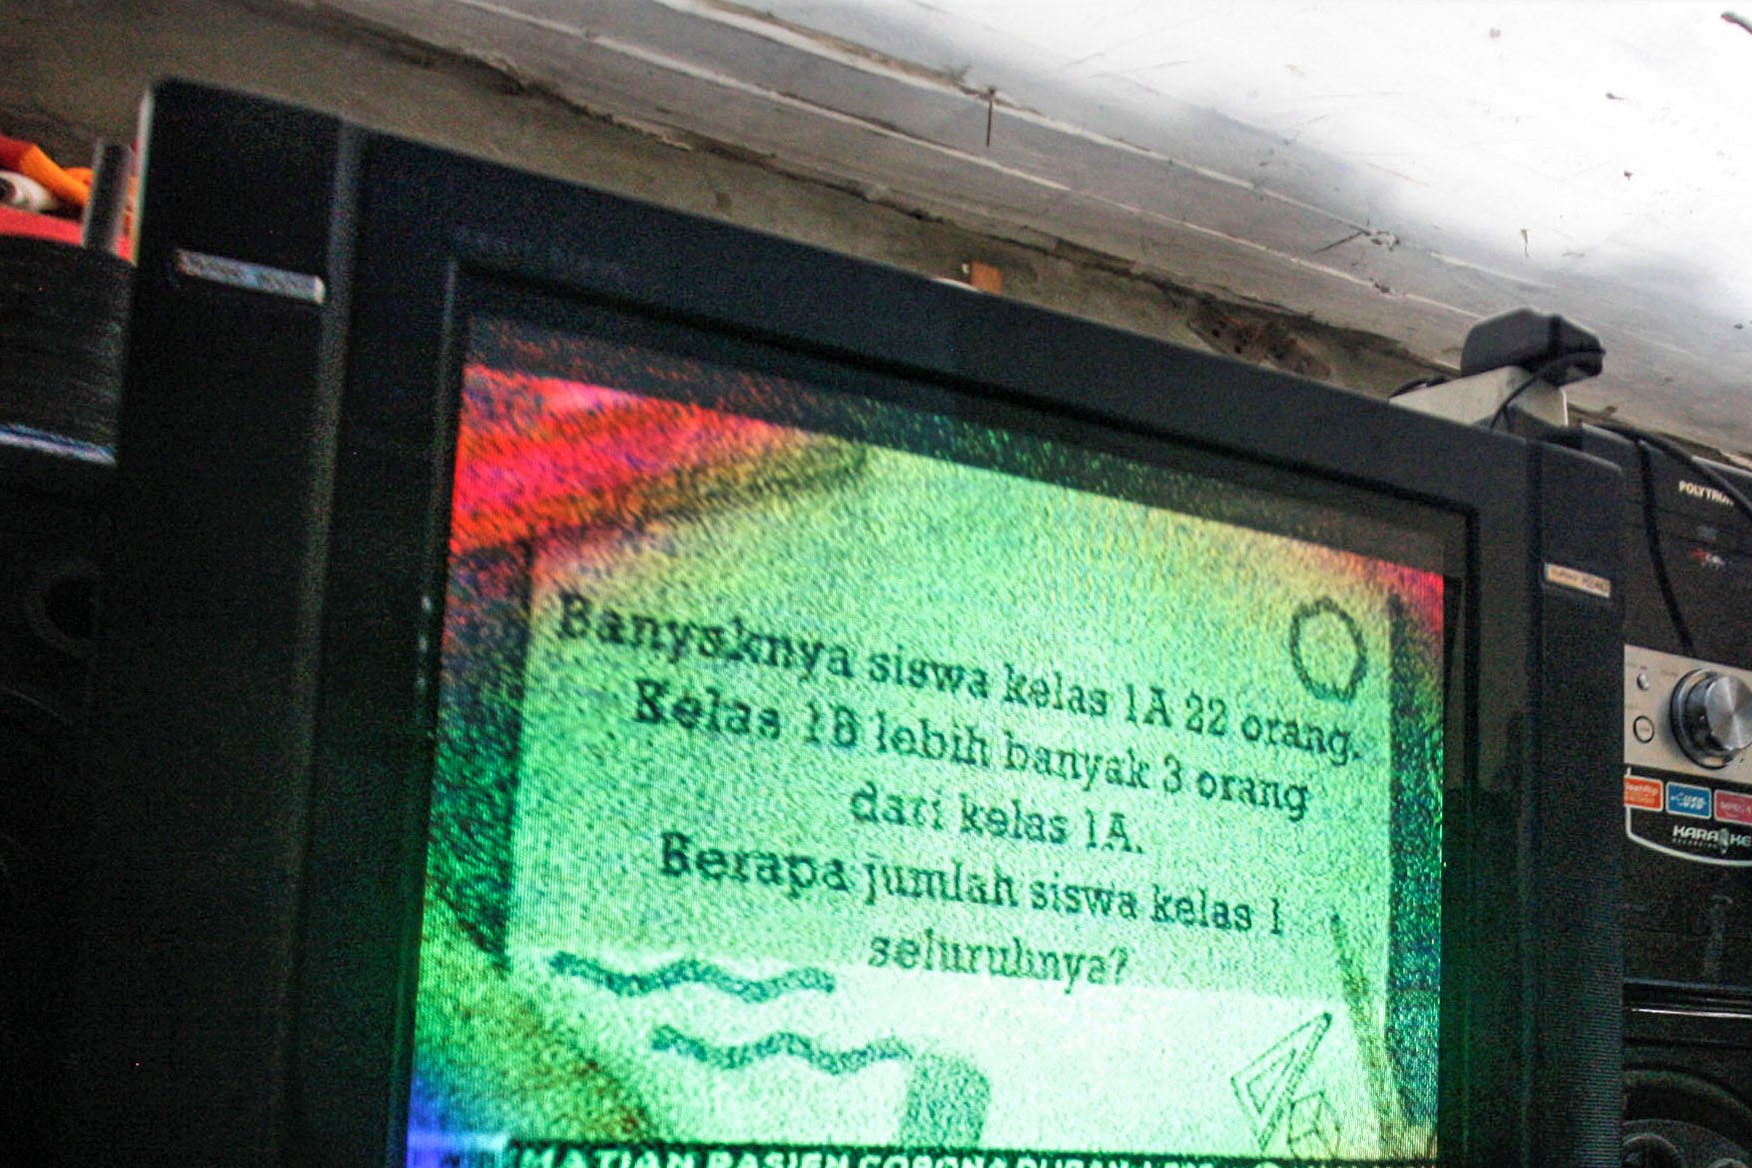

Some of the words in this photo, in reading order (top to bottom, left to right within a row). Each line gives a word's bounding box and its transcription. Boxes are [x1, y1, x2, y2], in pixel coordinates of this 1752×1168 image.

[633, 677, 782, 741] Kelas
[805, 700, 859, 749] 1B
[873, 707, 990, 767] lebih
[1003, 730, 1152, 793] banyak
[1162, 753, 1184, 796] 3
[1197, 771, 1310, 822] orang
[867, 644, 990, 700] siswa
[1003, 662, 1110, 717] kelas
[1125, 683, 1173, 729] 1A
[1184, 693, 1230, 737] 22
[1241, 712, 1361, 768] orang.
[850, 780, 942, 831] dari
[959, 793, 1069, 845] kelas
[1085, 808, 1146, 855] 1A.
[661, 831, 850, 900] Berapa
[862, 852, 1018, 907] jumlah
[1029, 872, 1138, 922] siswa
[1150, 883, 1254, 933] kelas
[1269, 898, 1284, 937] 1
[867, 928, 1130, 994] seluruhnya?
